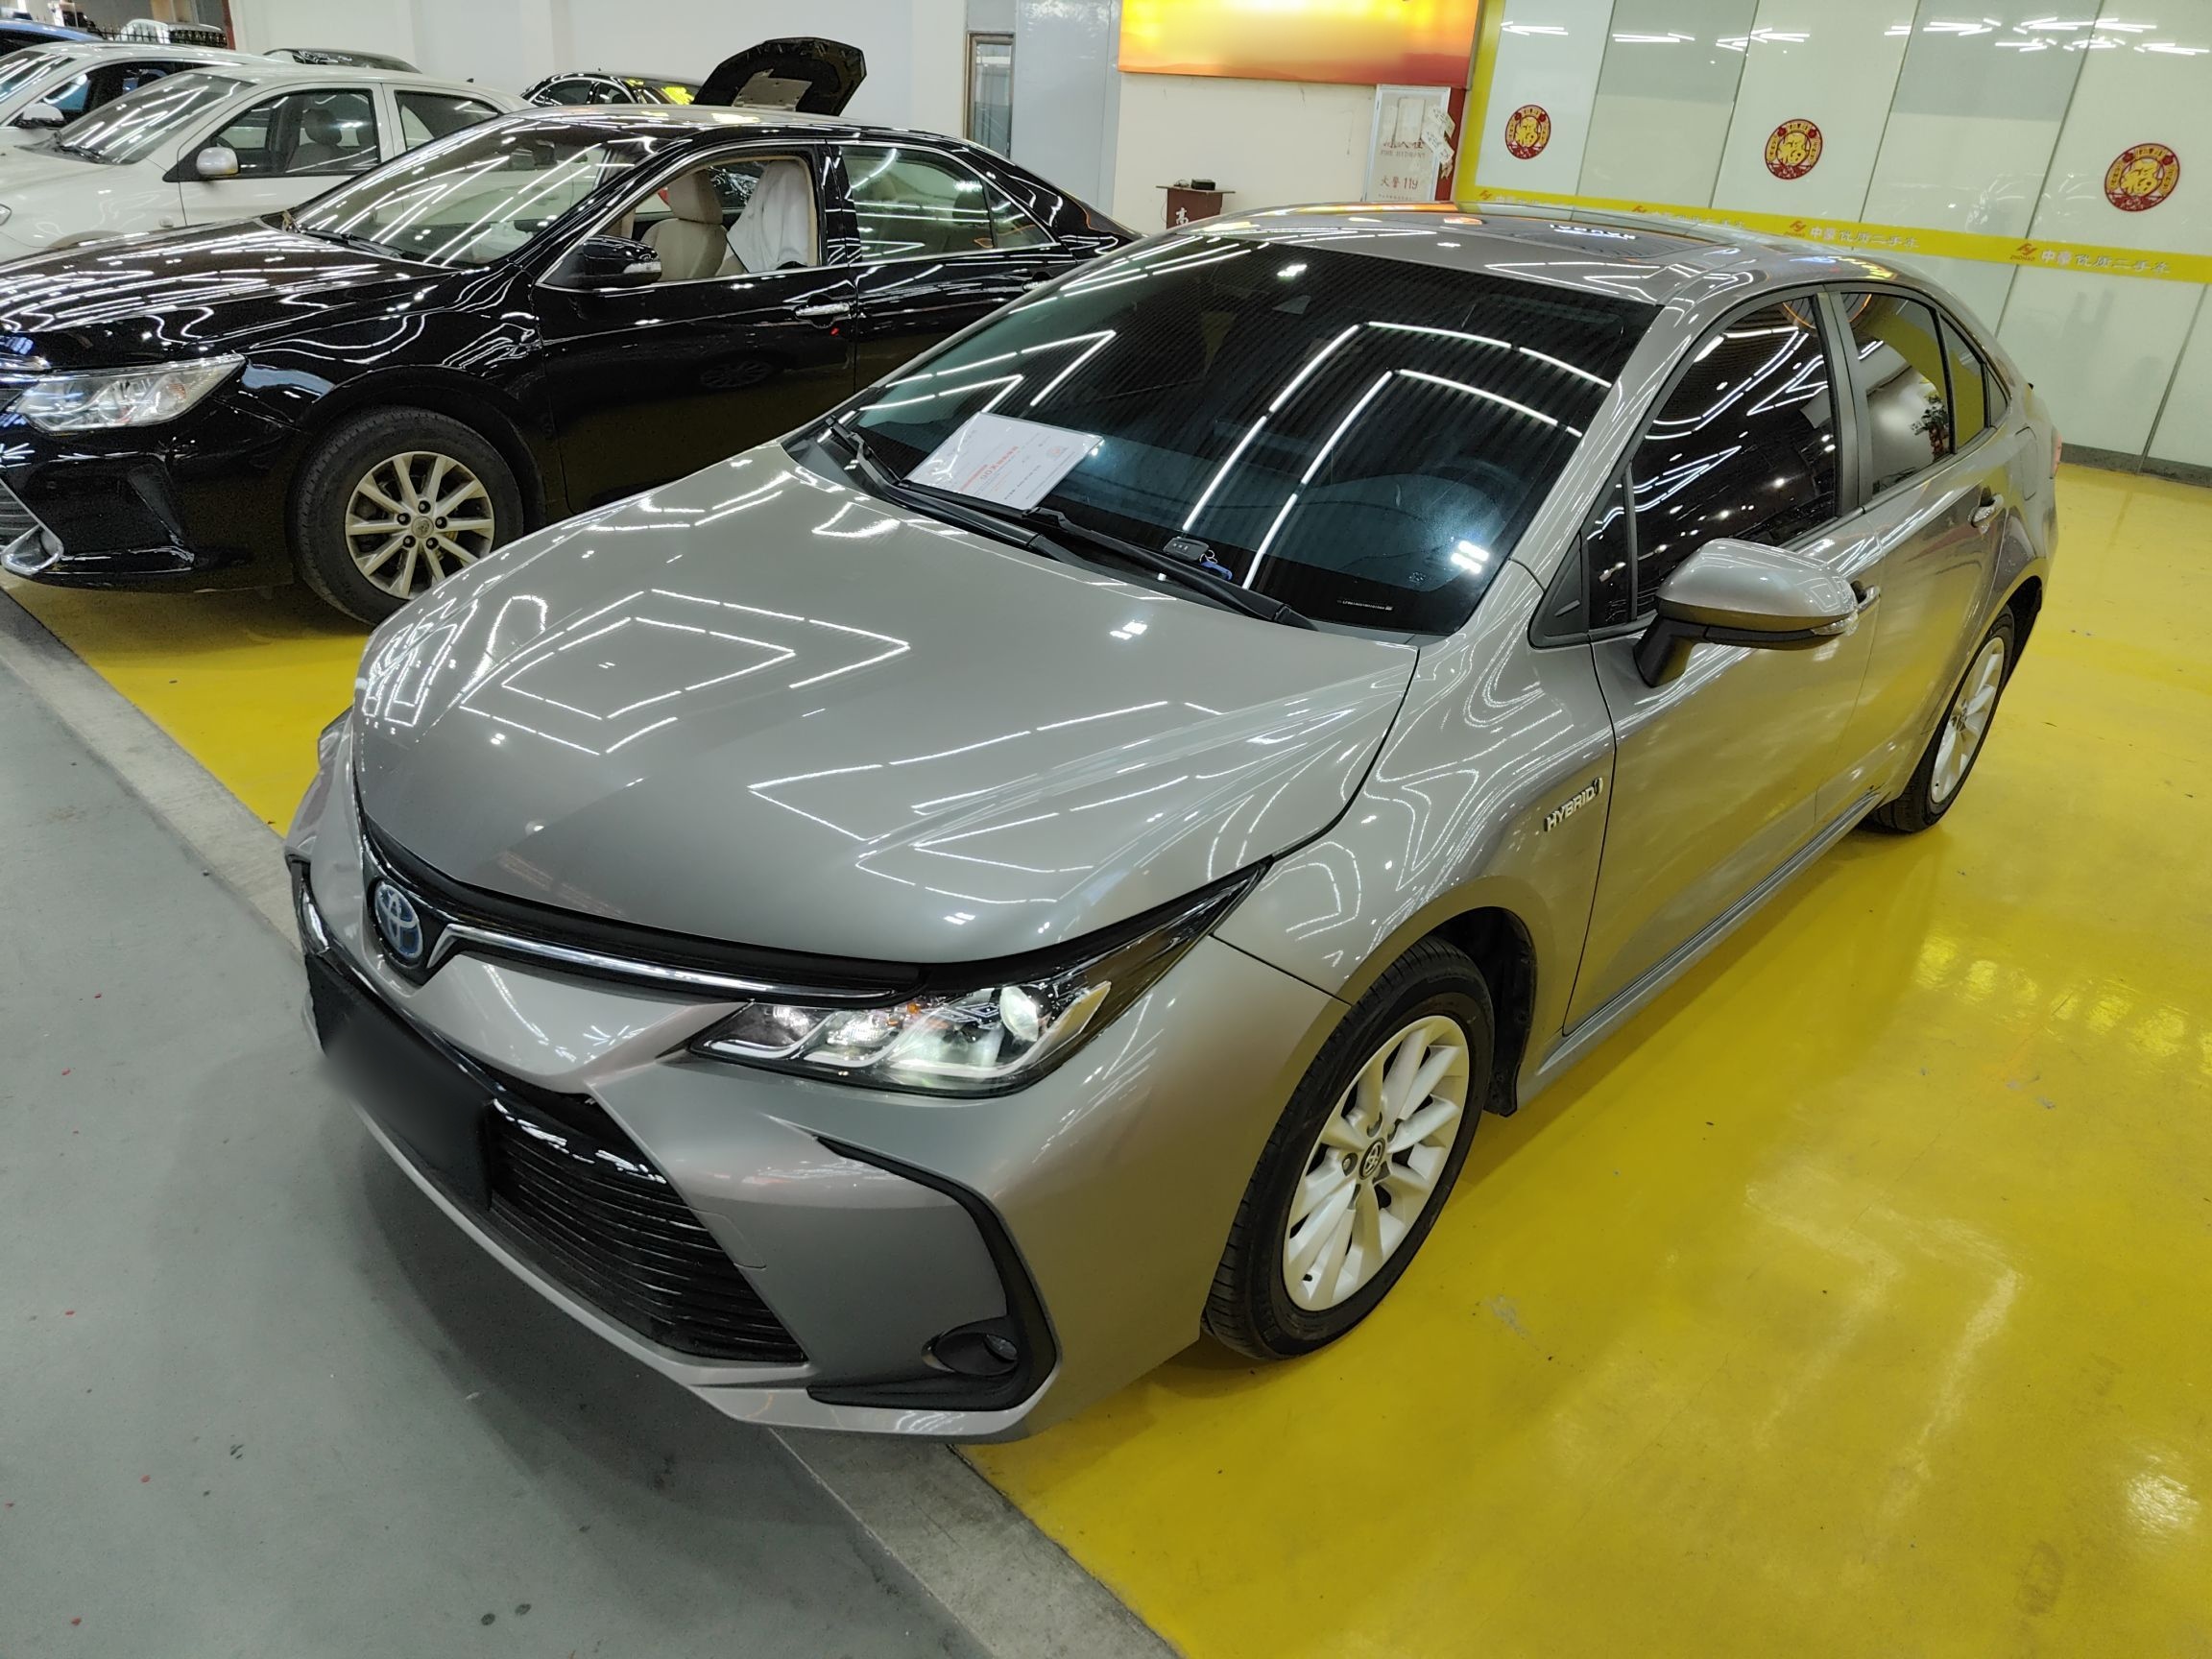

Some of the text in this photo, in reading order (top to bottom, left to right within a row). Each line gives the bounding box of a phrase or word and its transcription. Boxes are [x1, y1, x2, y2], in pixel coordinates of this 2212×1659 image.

[1404, 177, 1419, 190] 119
[1175, 207, 1190, 225] 高
[1545, 785, 1596, 831] HYBRID
